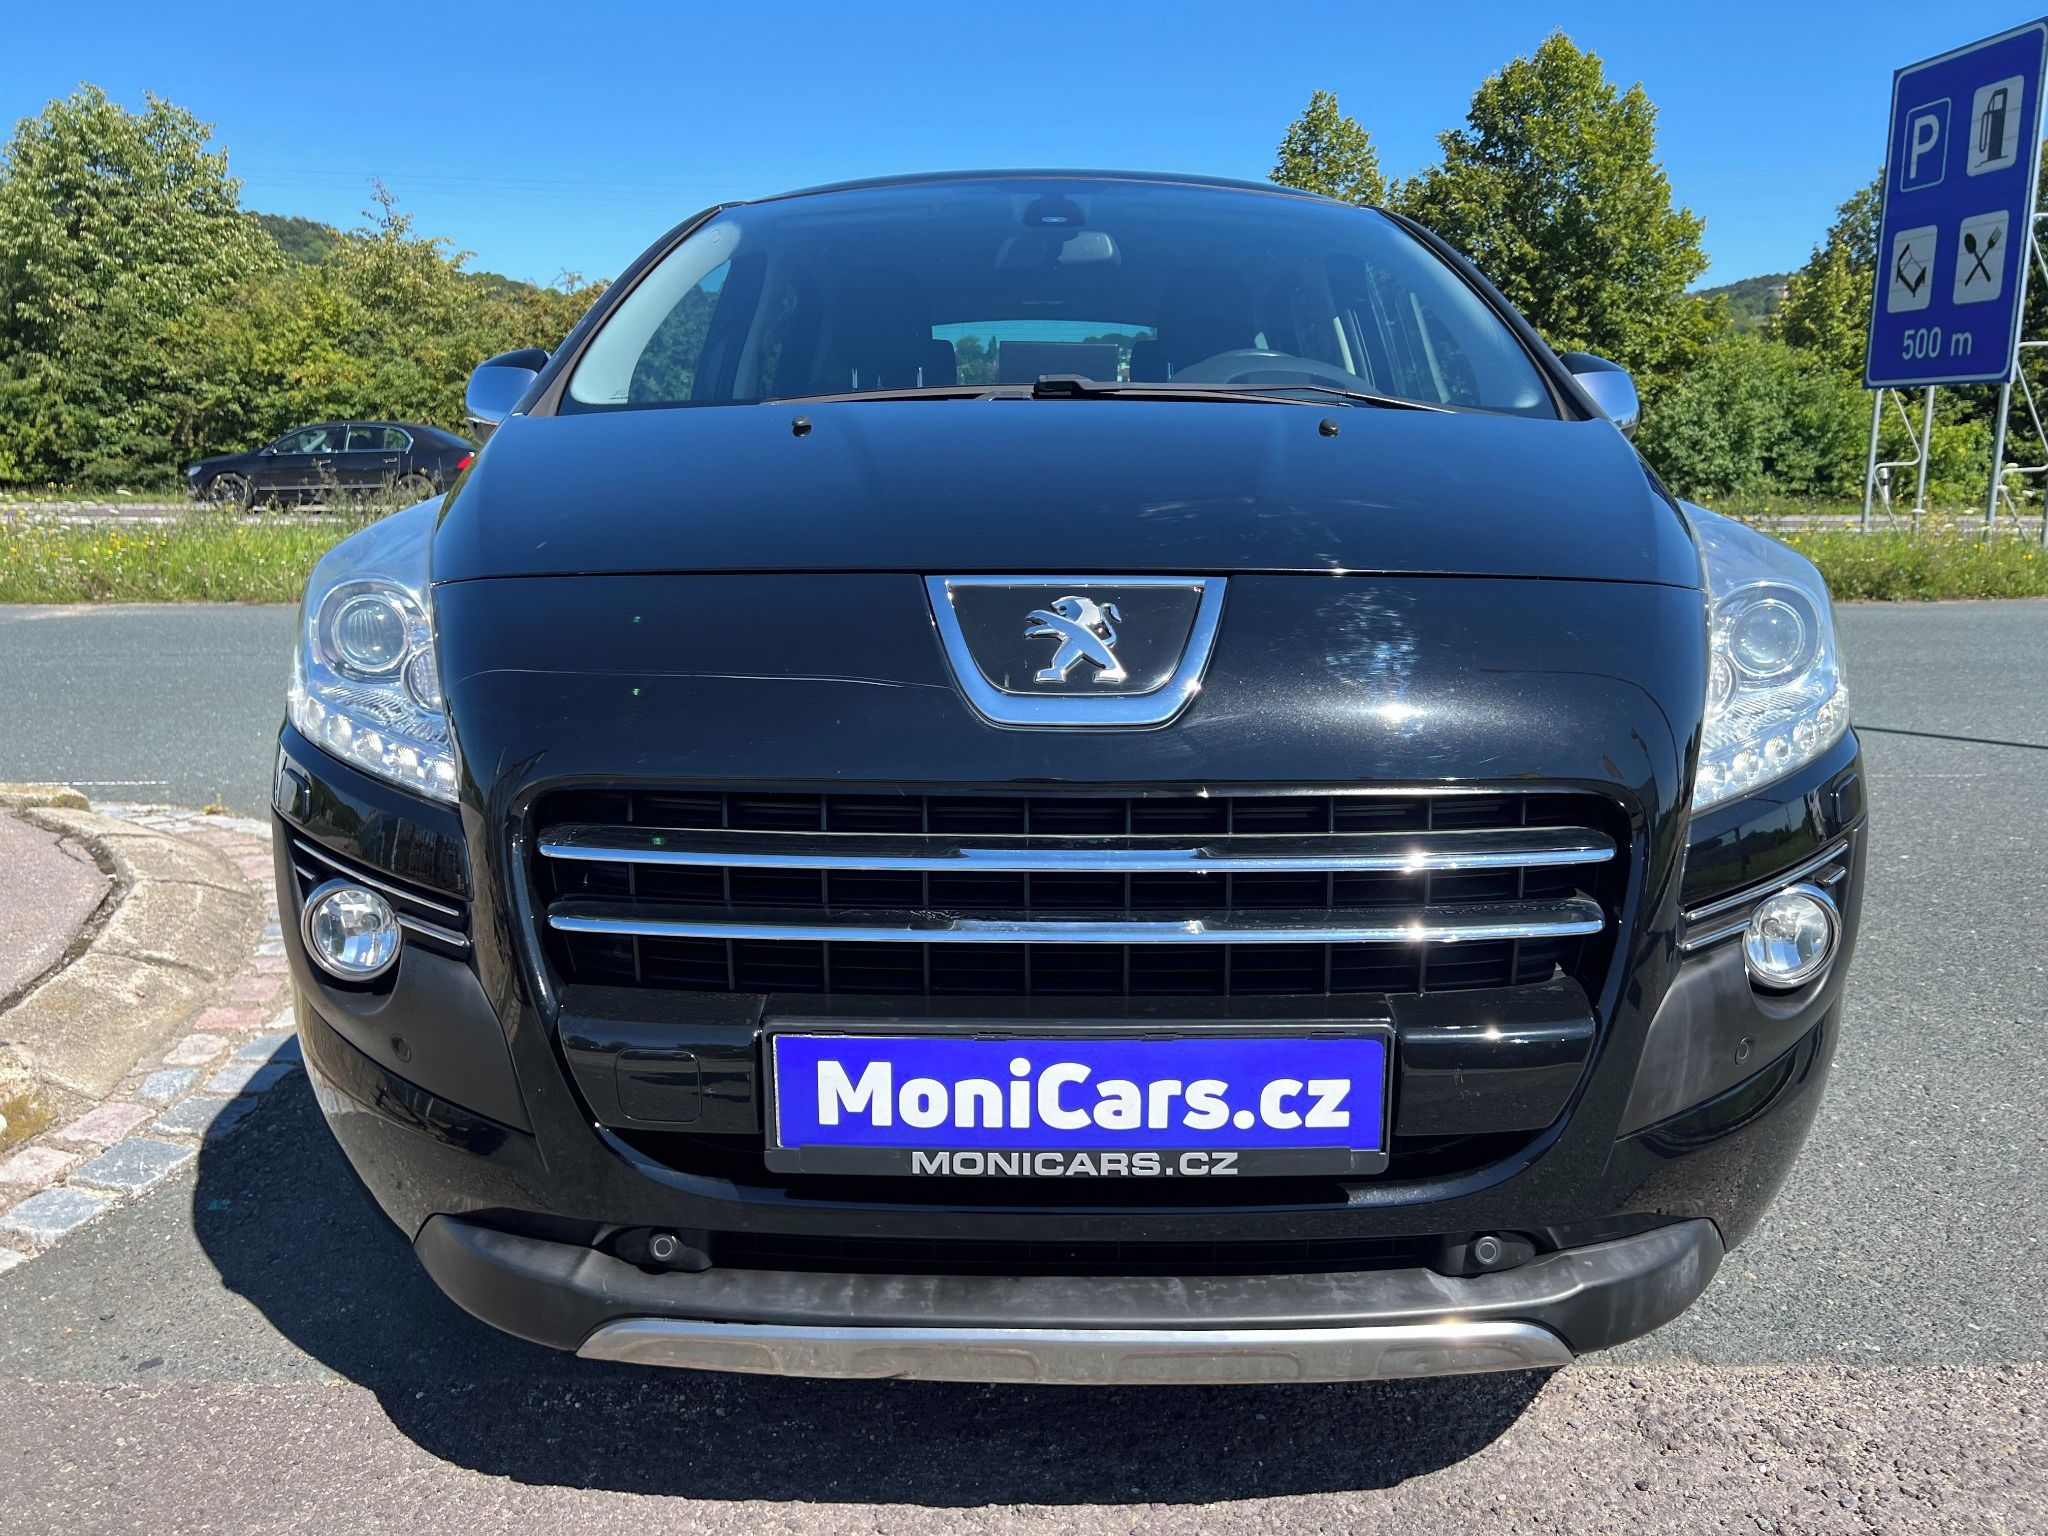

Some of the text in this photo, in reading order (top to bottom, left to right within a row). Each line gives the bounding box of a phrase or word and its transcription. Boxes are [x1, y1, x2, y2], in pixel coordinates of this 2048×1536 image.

[1908, 113, 1940, 180] P
[1902, 326, 1973, 361] 500 m
[816, 1056, 1351, 1130] MoniCars.cz
[910, 1150, 1240, 1177] MONICARS.CZ
